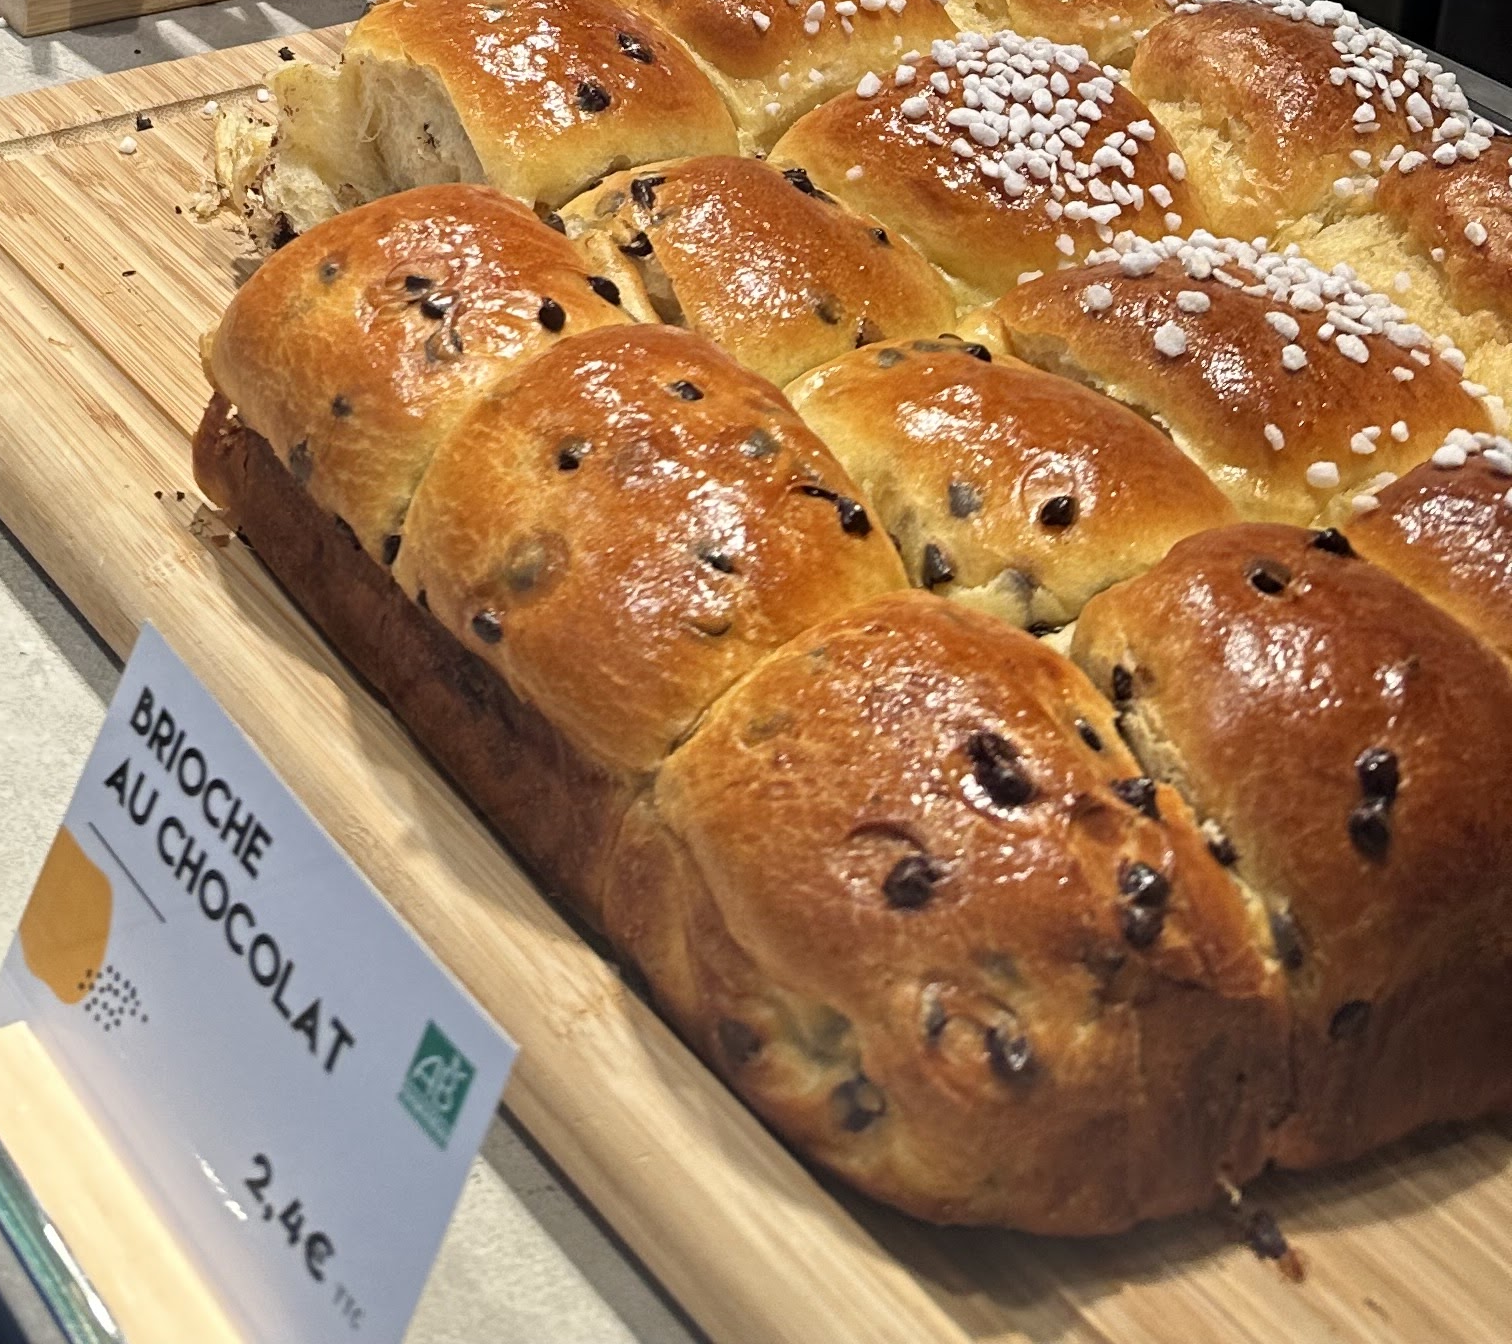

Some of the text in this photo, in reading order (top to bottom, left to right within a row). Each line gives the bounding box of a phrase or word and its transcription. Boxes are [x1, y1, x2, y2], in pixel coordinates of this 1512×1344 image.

[129, 685, 274, 880] BRIOCHE
[103, 757, 356, 1074] AU CHOCOLAT
[244, 1153, 335, 1283] 2,4€
